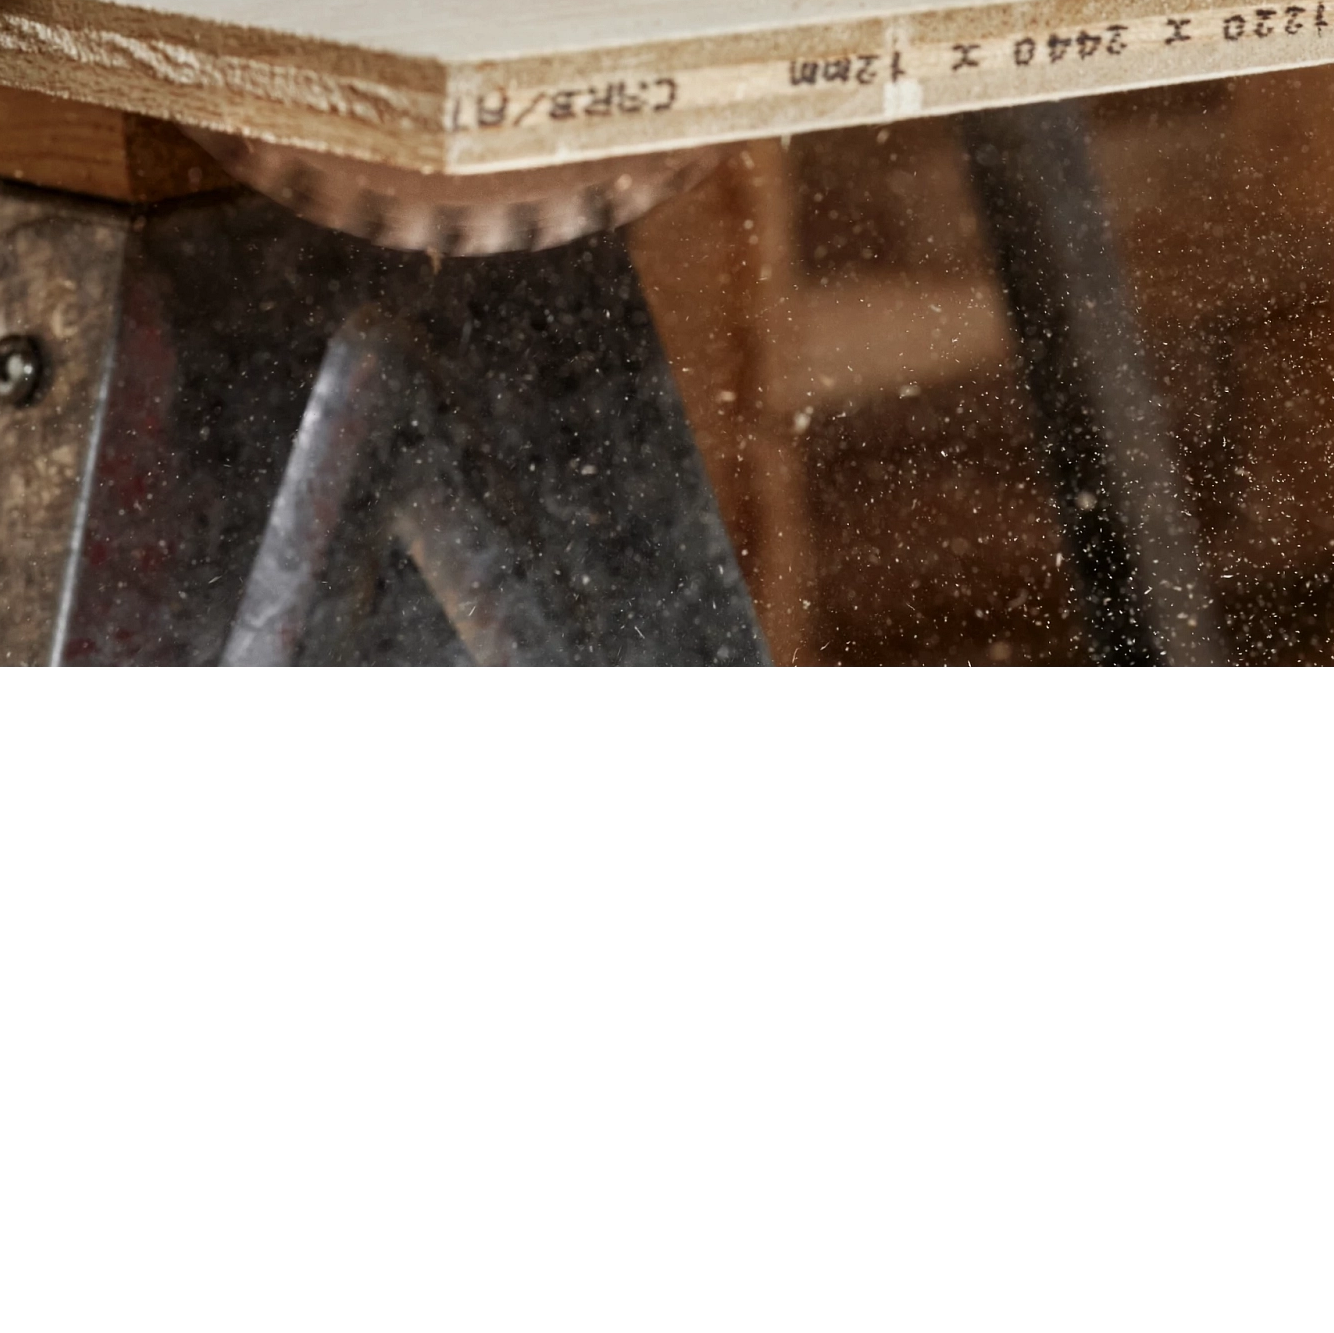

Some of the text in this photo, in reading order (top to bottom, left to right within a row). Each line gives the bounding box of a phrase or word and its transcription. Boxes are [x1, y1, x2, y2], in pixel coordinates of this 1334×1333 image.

[1222, 1, 1329, 41] 1220
[1013, 24, 1129, 67] 2440
[789, 49, 907, 87] 12mm
